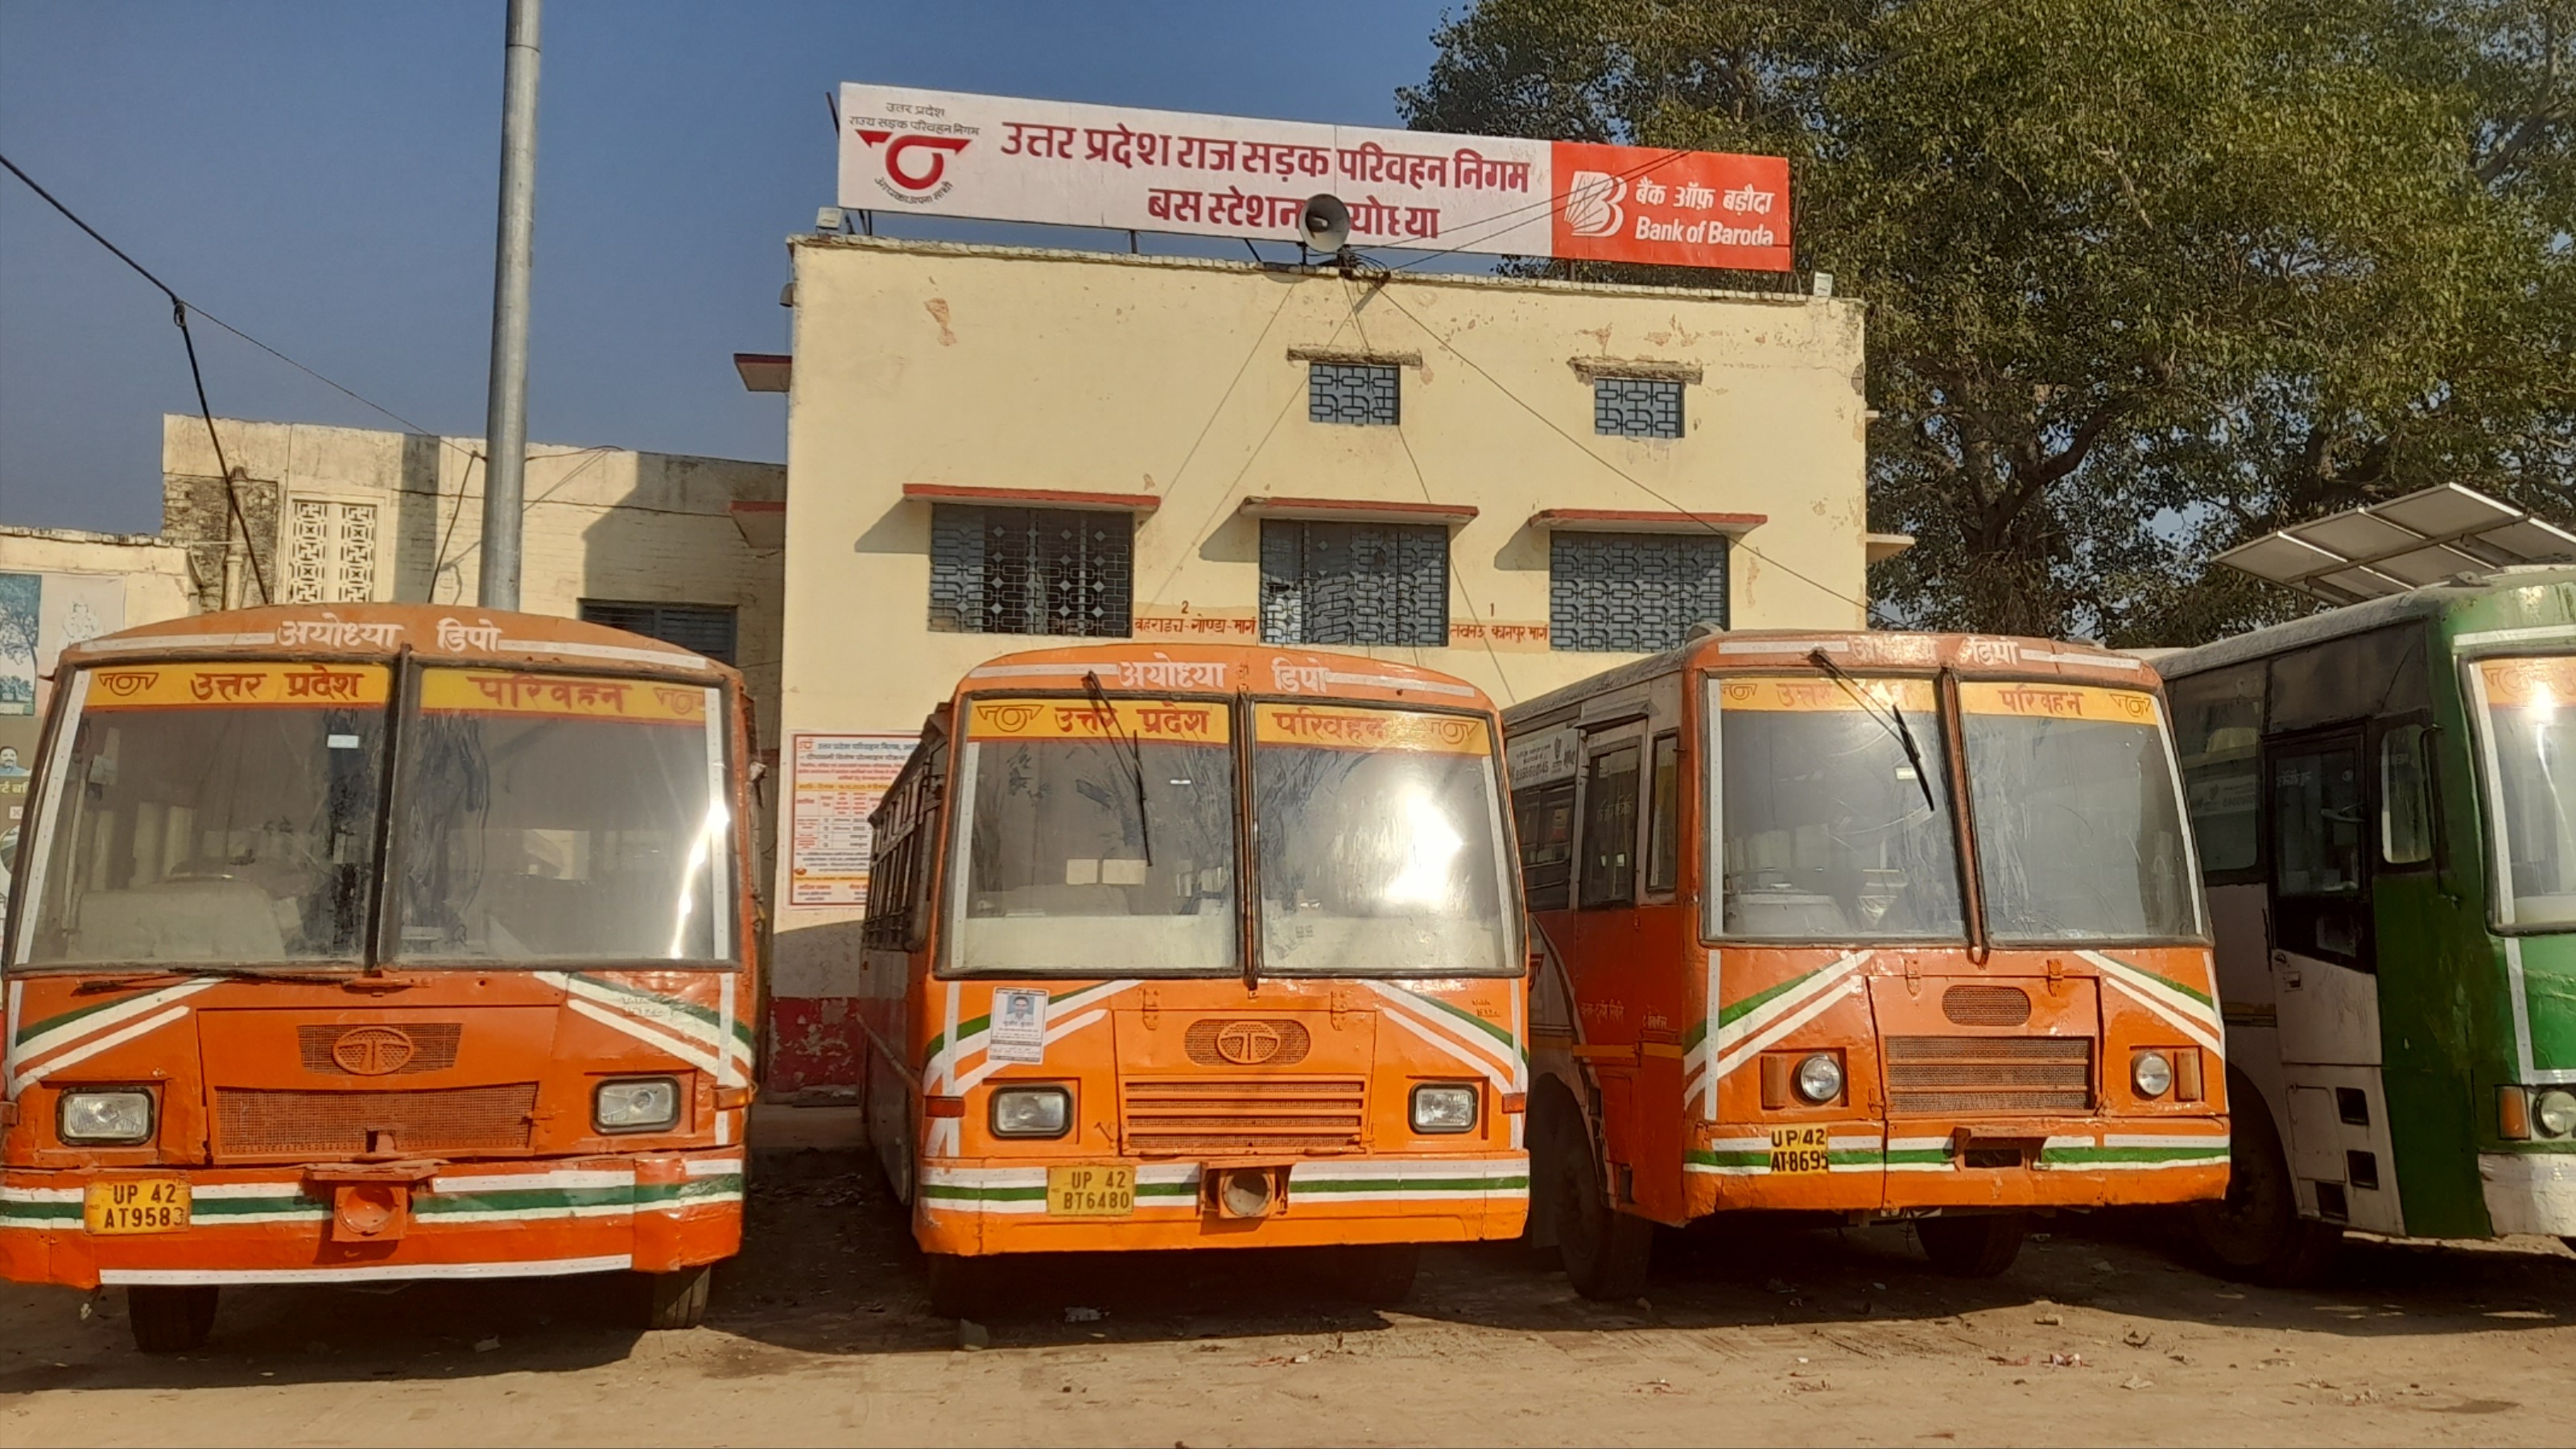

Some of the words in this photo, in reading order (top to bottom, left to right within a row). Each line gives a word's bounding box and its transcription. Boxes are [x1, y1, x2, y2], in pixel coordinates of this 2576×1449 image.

[910, 119, 952, 134] परिवहन
[914, 105, 945, 118] प्रदेश
[1001, 122, 1075, 160] उत्तर
[1084, 122, 1170, 168] प्रदेश
[1176, 136, 1238, 171] राज
[1241, 141, 1331, 184] सड़क
[1335, 140, 1449, 188] परिवहन
[1453, 147, 1530, 193] निगम
[1148, 188, 1202, 222] बस
[1208, 185, 1304, 229] स्टेशन
[1347, 195, 1441, 239] योध्या
[1635, 216, 1682, 242] Bank
[1686, 221, 1706, 243] of
[1707, 221, 1774, 247] Baroda
[1181, 601, 1189, 613] 2
[1490, 602, 1494, 617] 1
[278, 613, 403, 649] अयोध्या
[436, 617, 502, 653] डिपो
[190, 673, 267, 700] उत्तर
[283, 665, 365, 699] प्रदेश
[1118, 652, 1228, 688] अयोध्या
[1271, 657, 1330, 692] डिपो
[467, 674, 632, 713] परिवहन
[1998, 683, 2083, 716] परिवहन
[1136, 701, 1209, 734] प्रदेश
[1272, 707, 1389, 740] परिवहन
[114, 1184, 138, 1204] UP
[151, 1183, 176, 1203] 42
[1071, 1171, 1092, 1189] UP
[1105, 1171, 1126, 1188] 42
[1063, 1191, 1129, 1209] BT6480
[104, 1207, 184, 1228] AT9583
